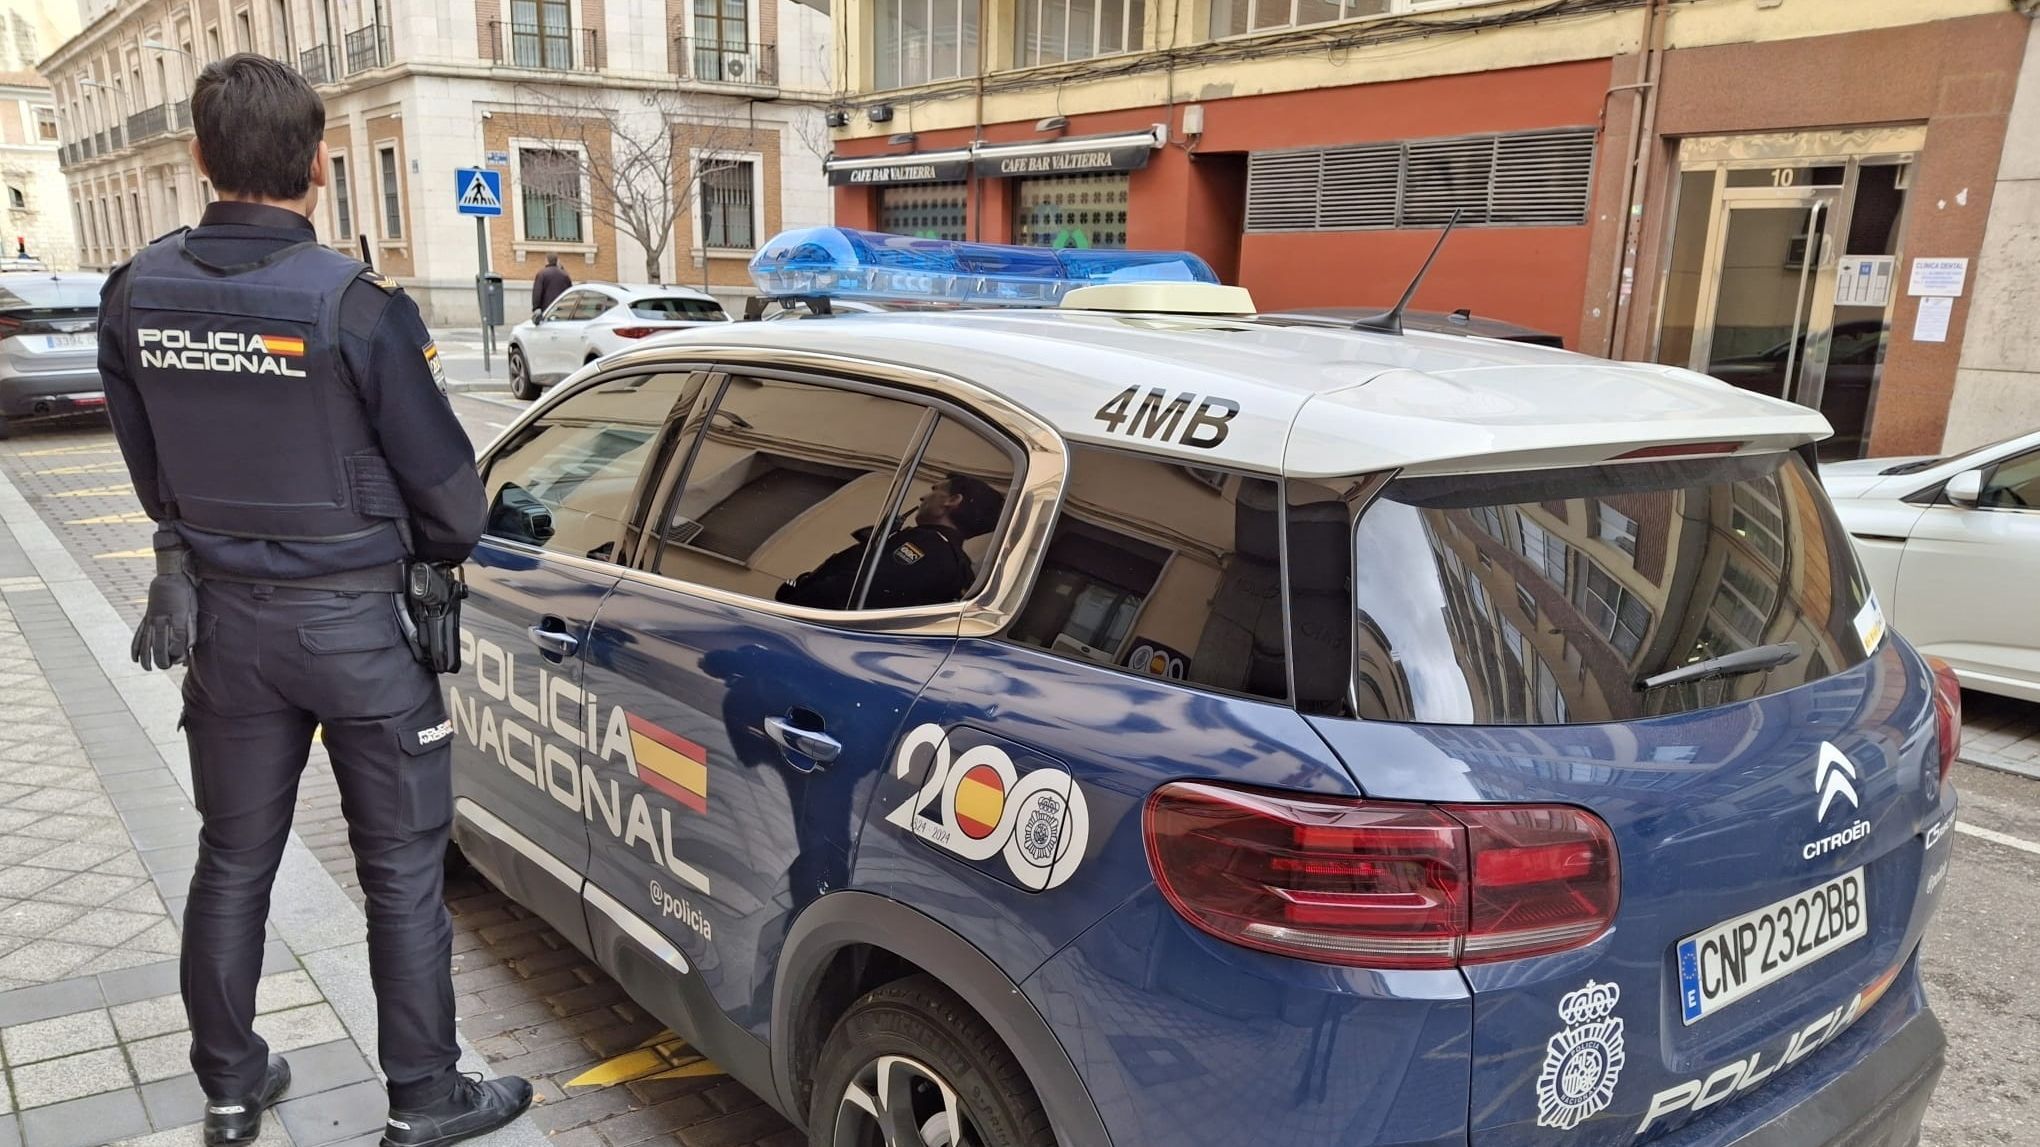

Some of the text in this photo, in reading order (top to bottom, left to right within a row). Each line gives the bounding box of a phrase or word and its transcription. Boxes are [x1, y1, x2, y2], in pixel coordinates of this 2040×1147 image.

[850, 165, 936, 182] CAFE BAR VALTIERRA
[1001, 152, 1113, 173] CAFE BAR VALTIERRA
[1771, 168, 1794, 187] 10
[137, 328, 269, 354] POLICIA
[140, 349, 307, 378] NACIONAL
[1094, 384, 1241, 449] 4MB
[450, 686, 711, 896] NACIONAL
[884, 722, 1090, 890] 200
[650, 879, 713, 942] @policia
[1687, 989, 1697, 1008] E
[1635, 993, 1862, 1135] POLICIA
